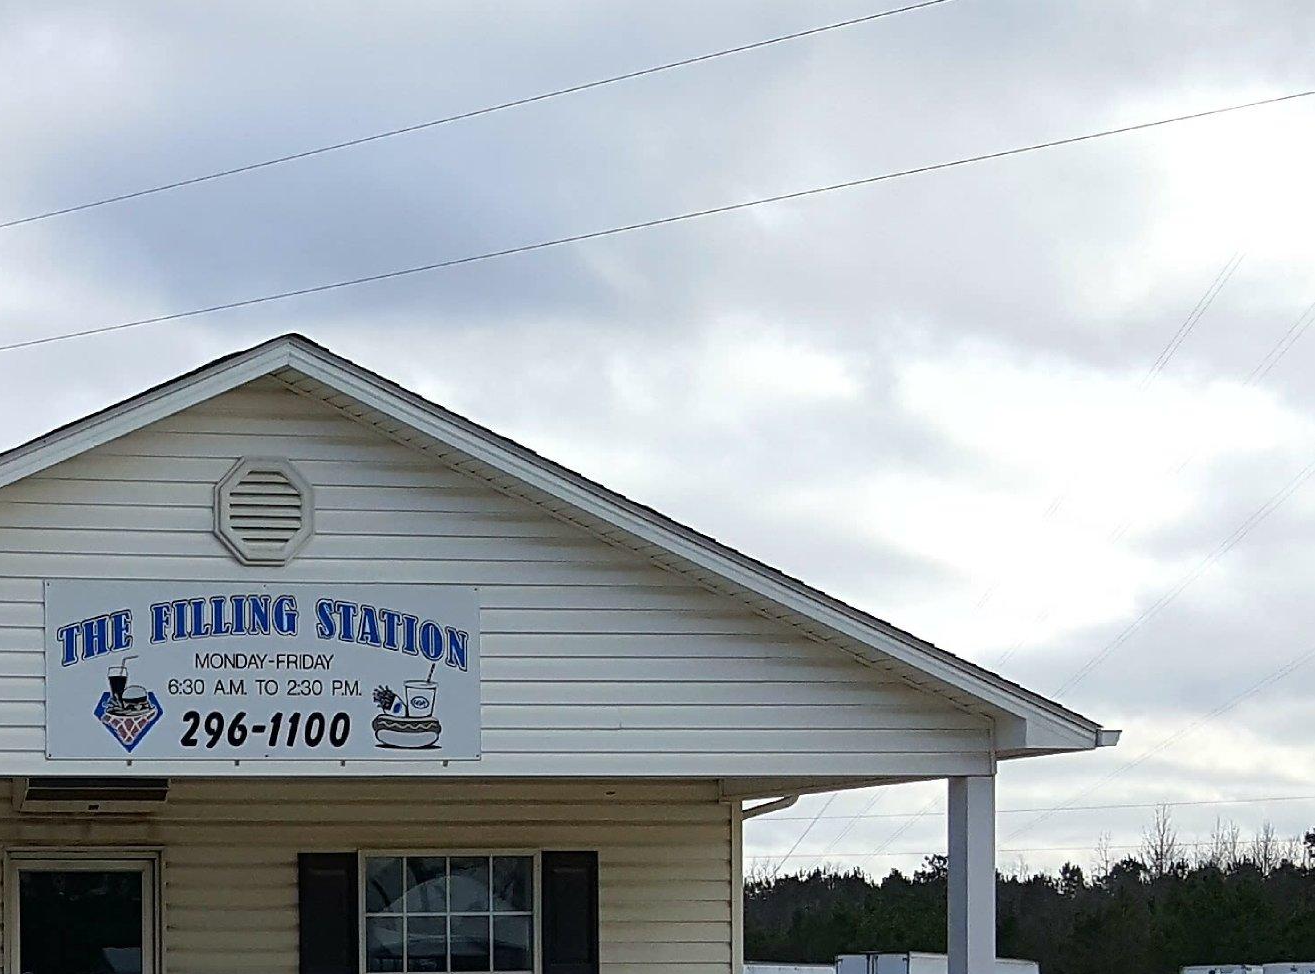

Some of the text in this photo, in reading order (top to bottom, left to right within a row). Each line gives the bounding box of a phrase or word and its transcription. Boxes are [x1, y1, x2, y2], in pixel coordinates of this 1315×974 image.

[57, 595, 468, 672] THE FILLING STATION
[195, 653, 334, 670] MONDAY-FRIDAY
[168, 679, 362, 696] 6:30 A.M. TO 2:30 P.M.
[180, 710, 351, 749] 296-1100
